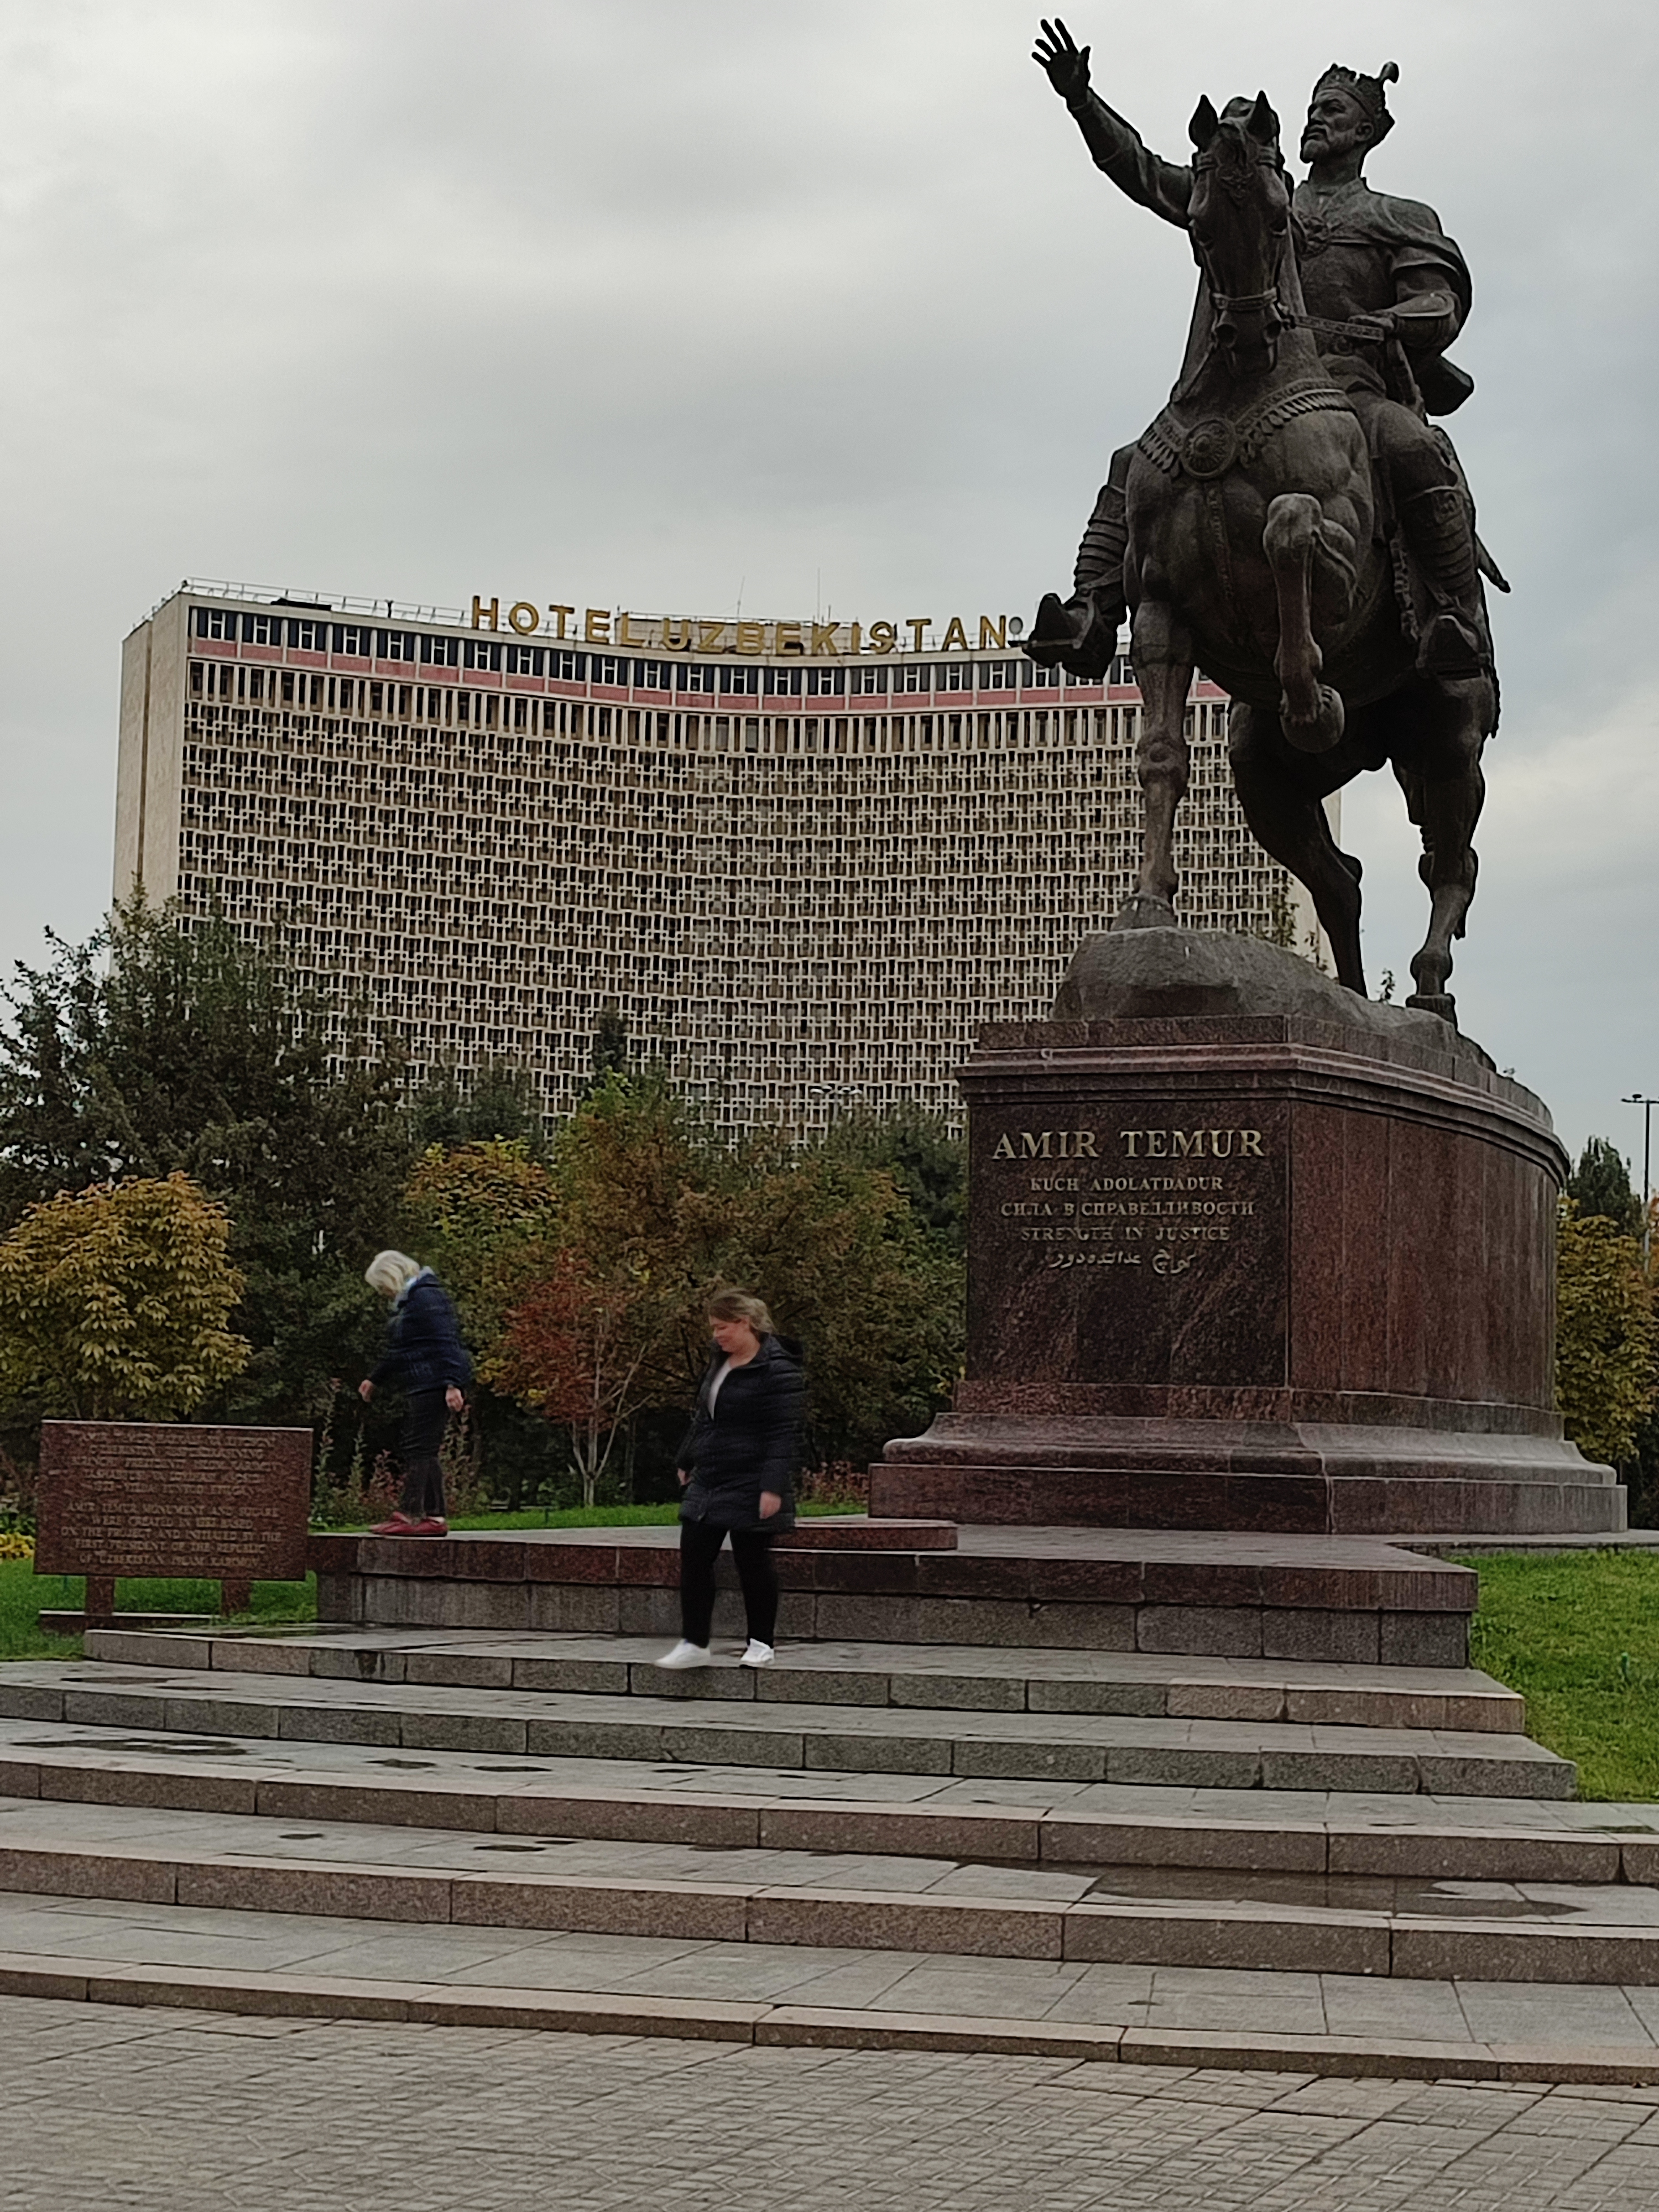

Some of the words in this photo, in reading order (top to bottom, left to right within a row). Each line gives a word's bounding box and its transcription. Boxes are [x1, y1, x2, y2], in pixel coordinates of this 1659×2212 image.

[472, 595, 645, 647] HOTEL
[663, 615, 1008, 656] UZBEKISTAN
[992, 1131, 1099, 1160] AMIR
[1120, 1130, 1266, 1159] TEMUR
[1030, 1177, 1079, 1191] KUCH
[1090, 1177, 1224, 1191] ADOLATDADUR
[1000, 1202, 1053, 1216] СИЛА
[1064, 1202, 1074, 1215] В
[1081, 1201, 1254, 1216] СПРАВЕДЛИВОСТИ
[1020, 1226, 1114, 1241] STRENGTH
[1125, 1227, 1143, 1240] IN
[1155, 1226, 1230, 1241] JUSTICE
